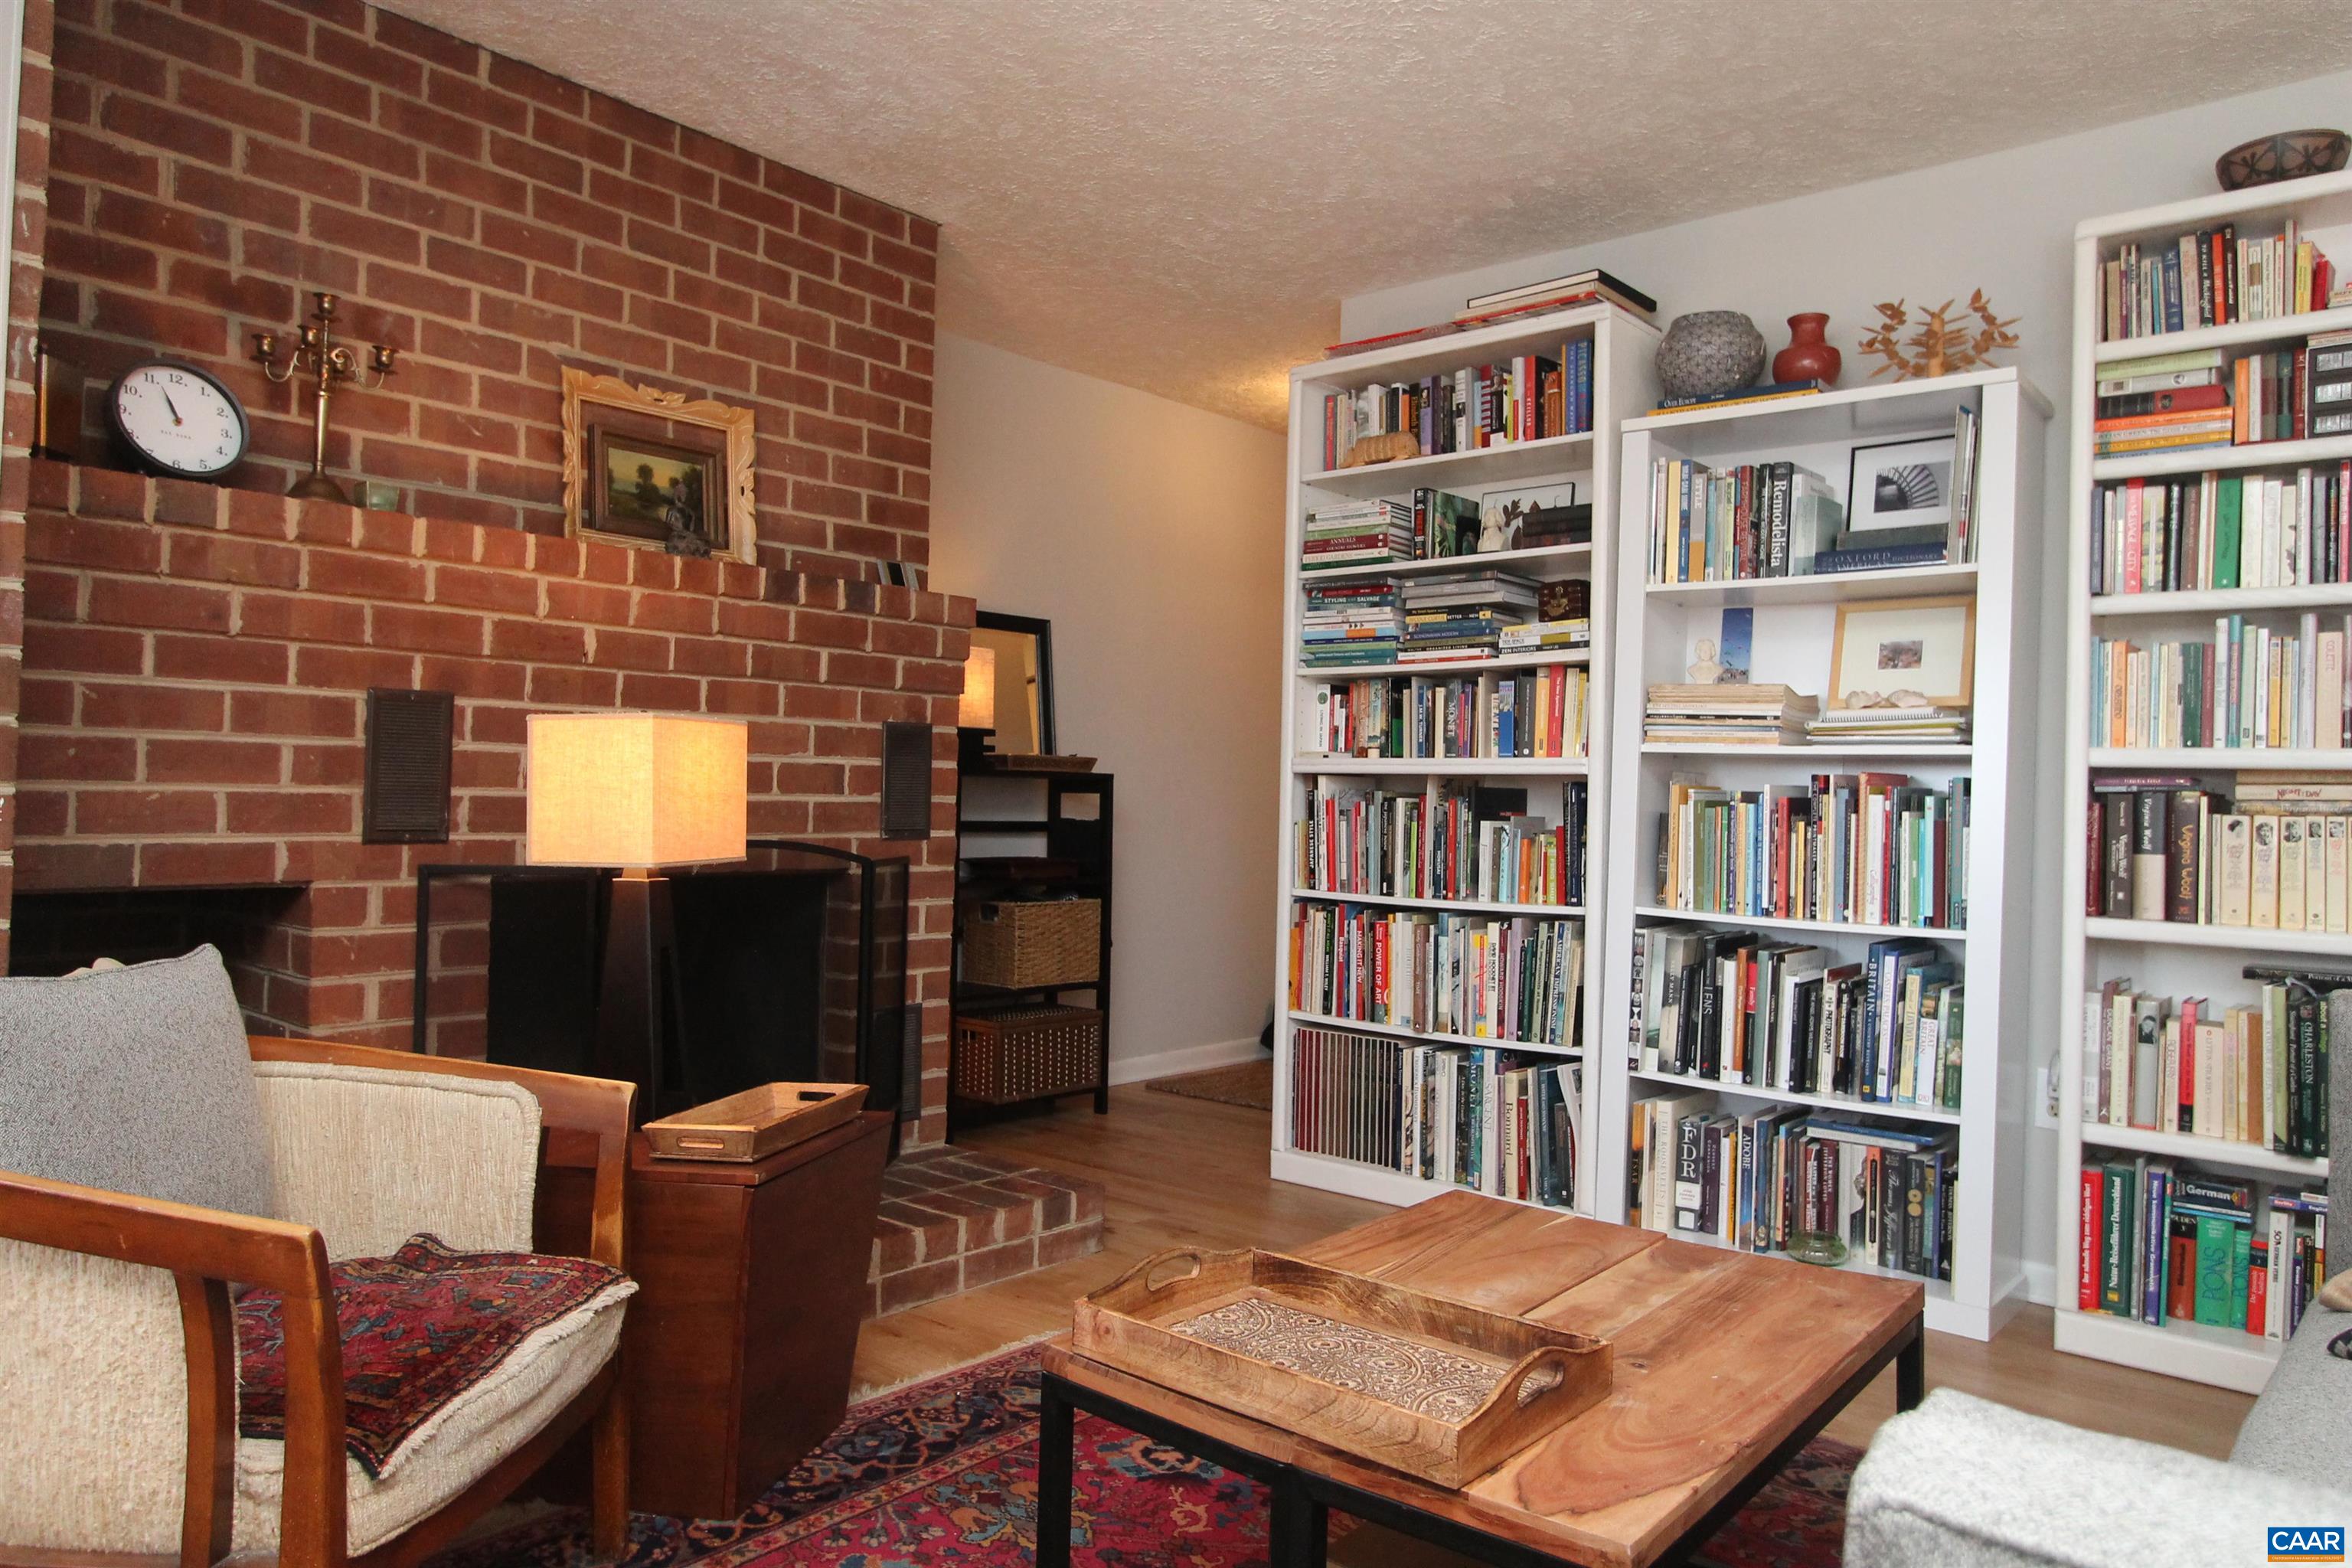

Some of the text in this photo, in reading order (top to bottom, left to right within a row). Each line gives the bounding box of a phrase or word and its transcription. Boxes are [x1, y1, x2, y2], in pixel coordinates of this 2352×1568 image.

[1771, 480, 1787, 567] Remodelista
[1447, 702, 1455, 737] MONET
[2141, 798, 2151, 851] Virginia Woolf
[2178, 824, 2194, 900] Virginia Woolf
[1375, 974, 1382, 985] OF
[1550, 978, 1559, 1029] IMPRESSIONISM
[1703, 986, 1713, 1014] LENS
[1867, 962, 1877, 1012] BRITAIN
[1823, 1009, 1832, 1055] PHOTOGRAPHY
[2303, 1022, 2314, 1084] CHARLESTON
[2318, 1029, 2327, 1054] village
[1483, 1082, 1492, 1132] SARGENT
[1505, 1102, 1514, 1156] Bonnard
[1659, 1141, 1668, 1201] ROOSEVELTS
[1681, 1129, 1697, 1178] FDR
[1743, 1133, 1752, 1170] ADOBE
[2186, 1184, 2231, 1200] German
[2150, 1200, 2158, 1252] kommunikative
[2202, 1246, 2226, 1302] PONS
